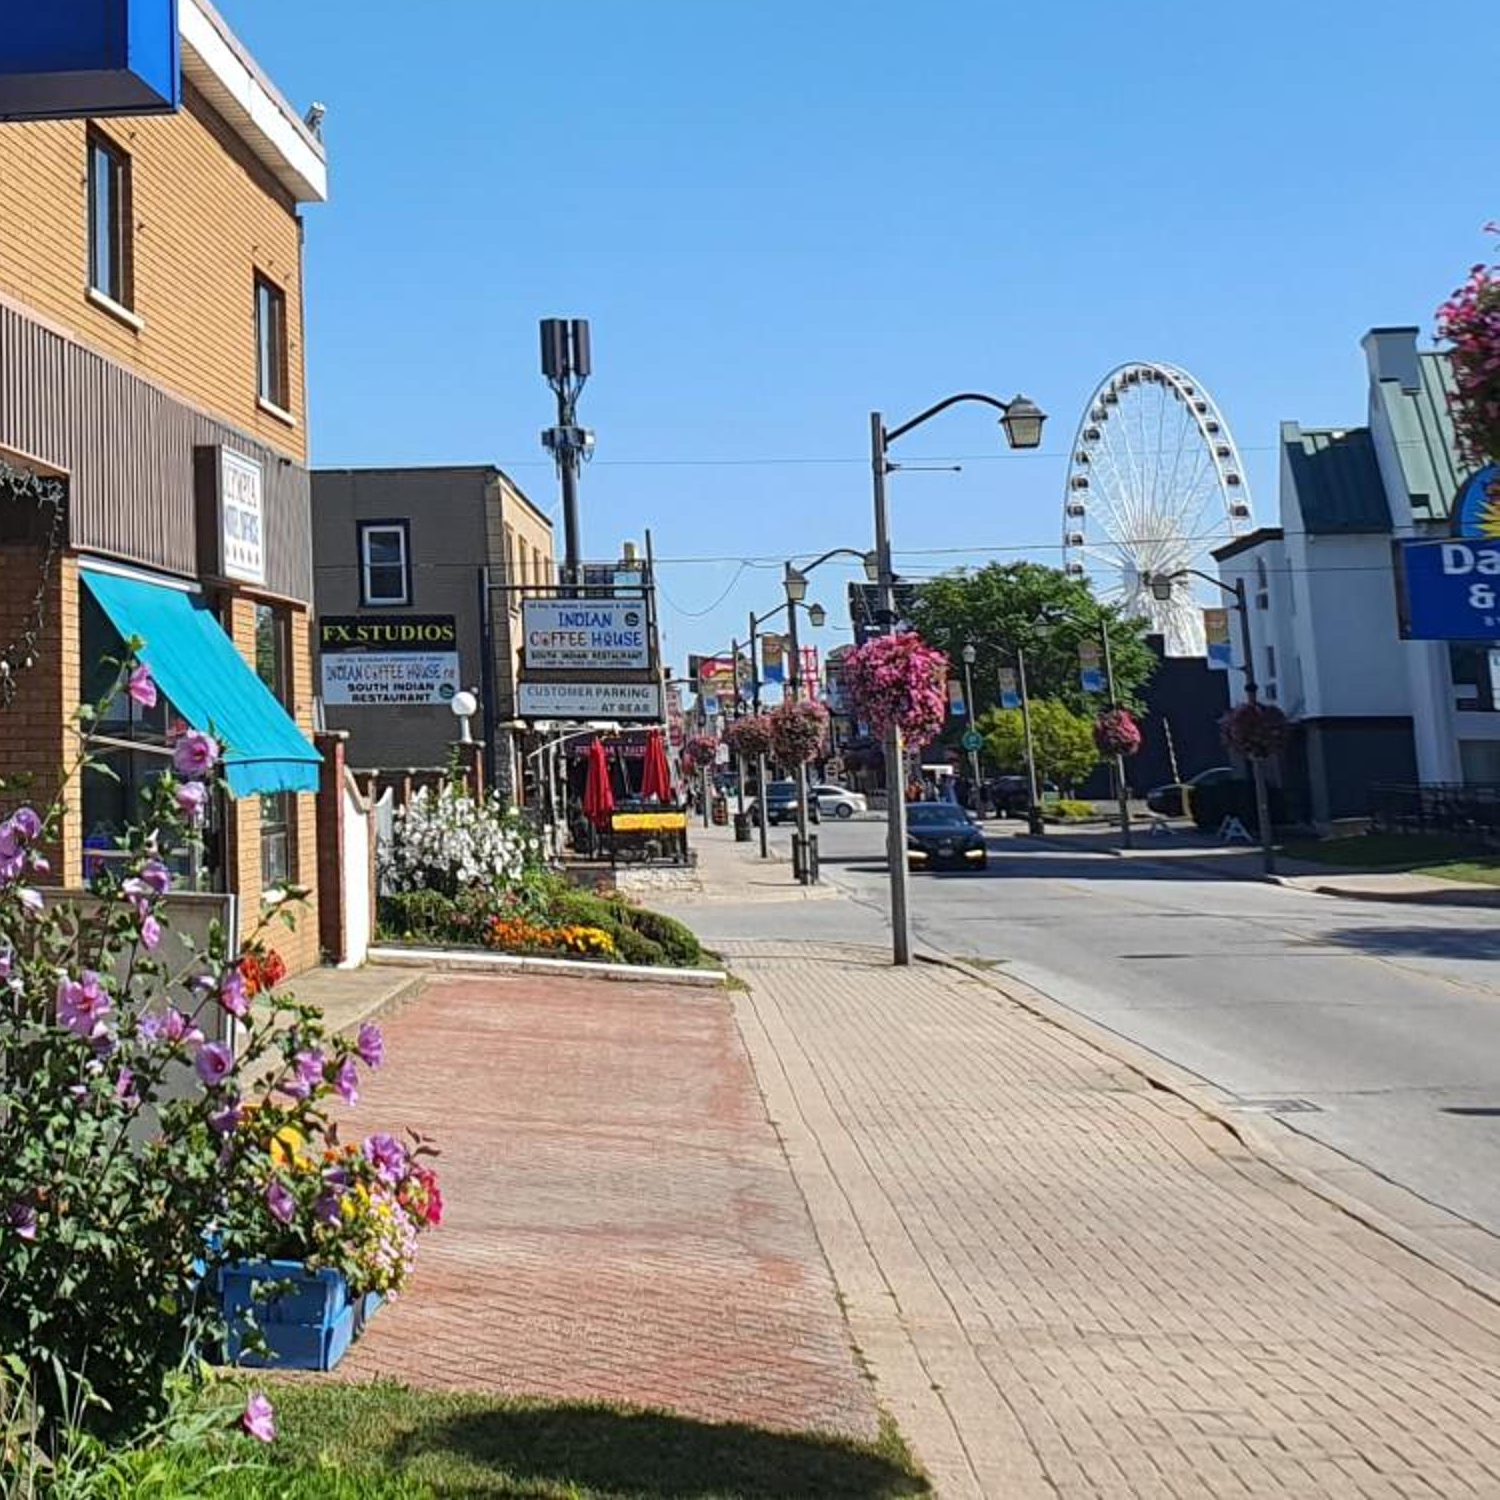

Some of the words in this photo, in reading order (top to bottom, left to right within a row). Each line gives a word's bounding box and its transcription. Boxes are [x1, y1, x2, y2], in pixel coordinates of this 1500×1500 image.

[558, 611, 612, 628] INDIAN
[323, 625, 350, 641] FX
[357, 625, 454, 641] STUDIOS
[347, 682, 389, 692] SOUTH
[393, 682, 435, 691] INDIAN
[527, 685, 592, 697] CUSTOMER
[595, 686, 649, 698] PARKING
[352, 693, 431, 702] RESTAURANT
[601, 702, 616, 712] AT
